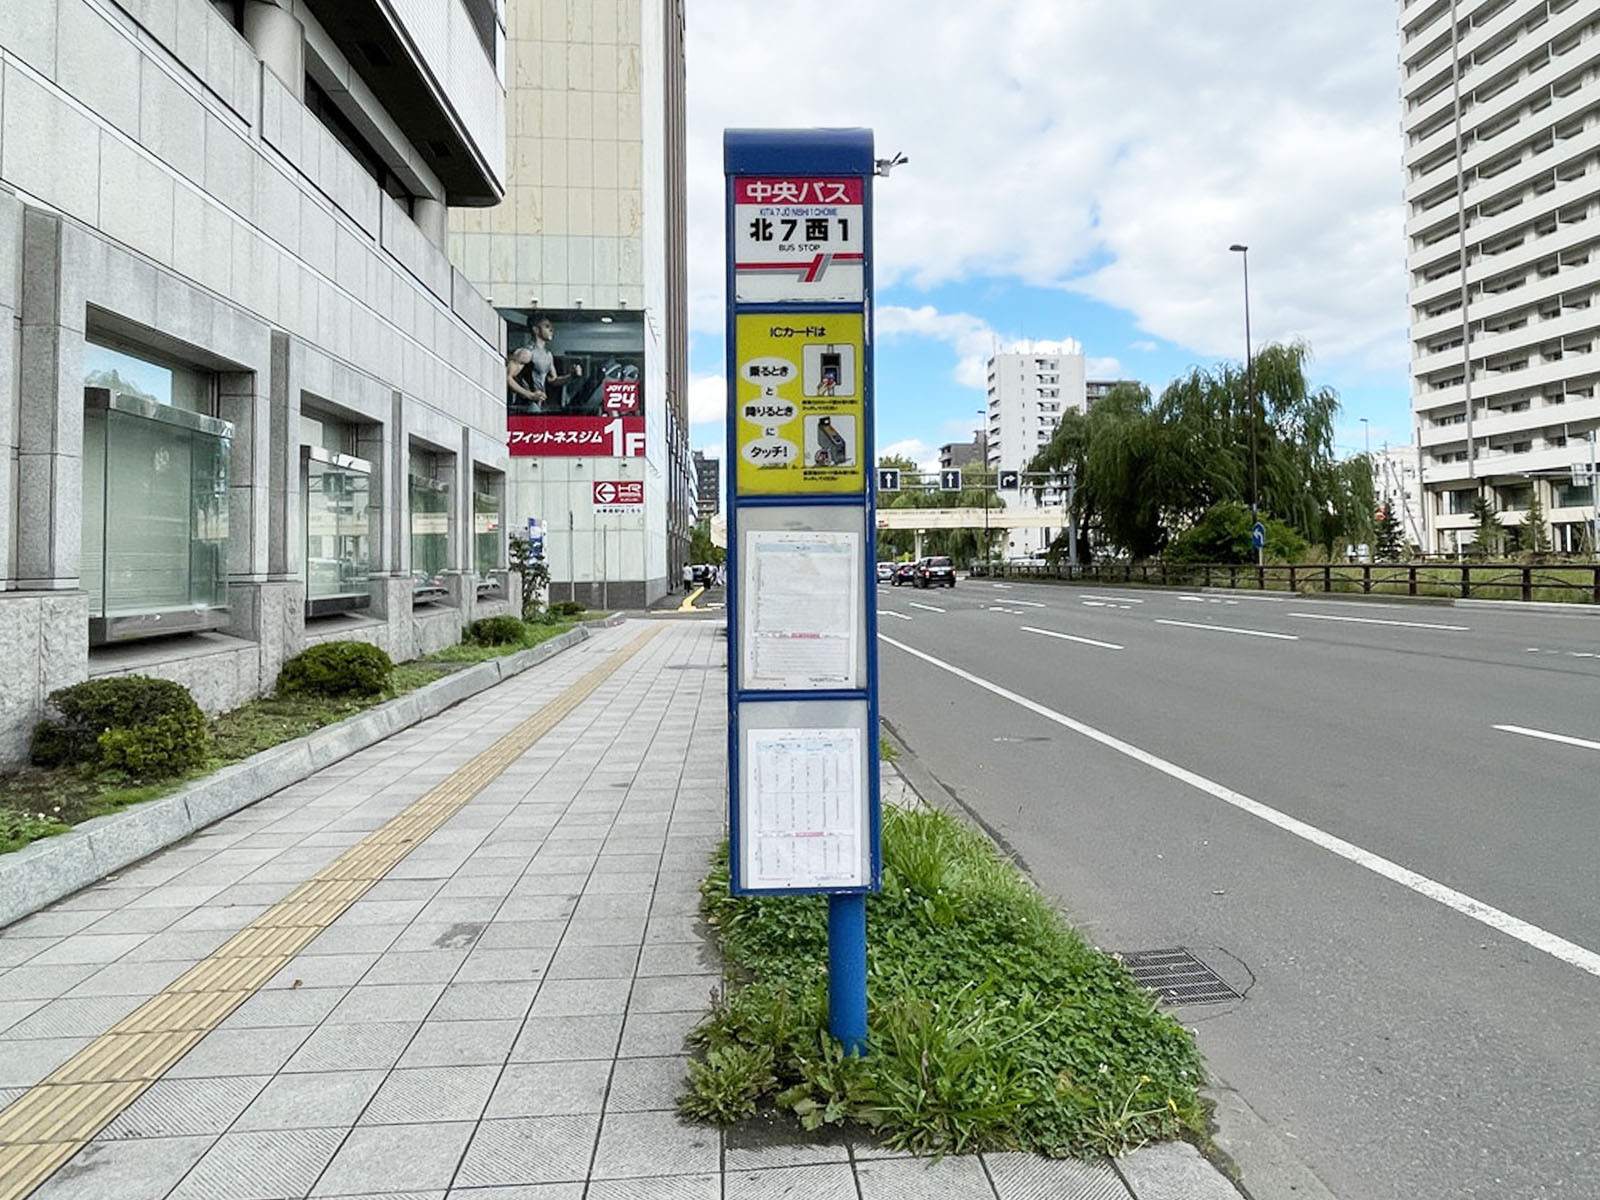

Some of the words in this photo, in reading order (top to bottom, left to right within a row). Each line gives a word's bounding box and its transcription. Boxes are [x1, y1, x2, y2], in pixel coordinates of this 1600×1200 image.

[746, 181, 850, 203] 中央バス
[778, 244, 796, 252] BUS
[798, 244, 820, 252] STOP
[769, 326, 827, 338] ICカードは
[765, 387, 774, 396] と
[606, 393, 636, 409] 24
[507, 430, 603, 444] フィットネスジム
[603, 418, 645, 457] 1F
[765, 428, 775, 437] に
